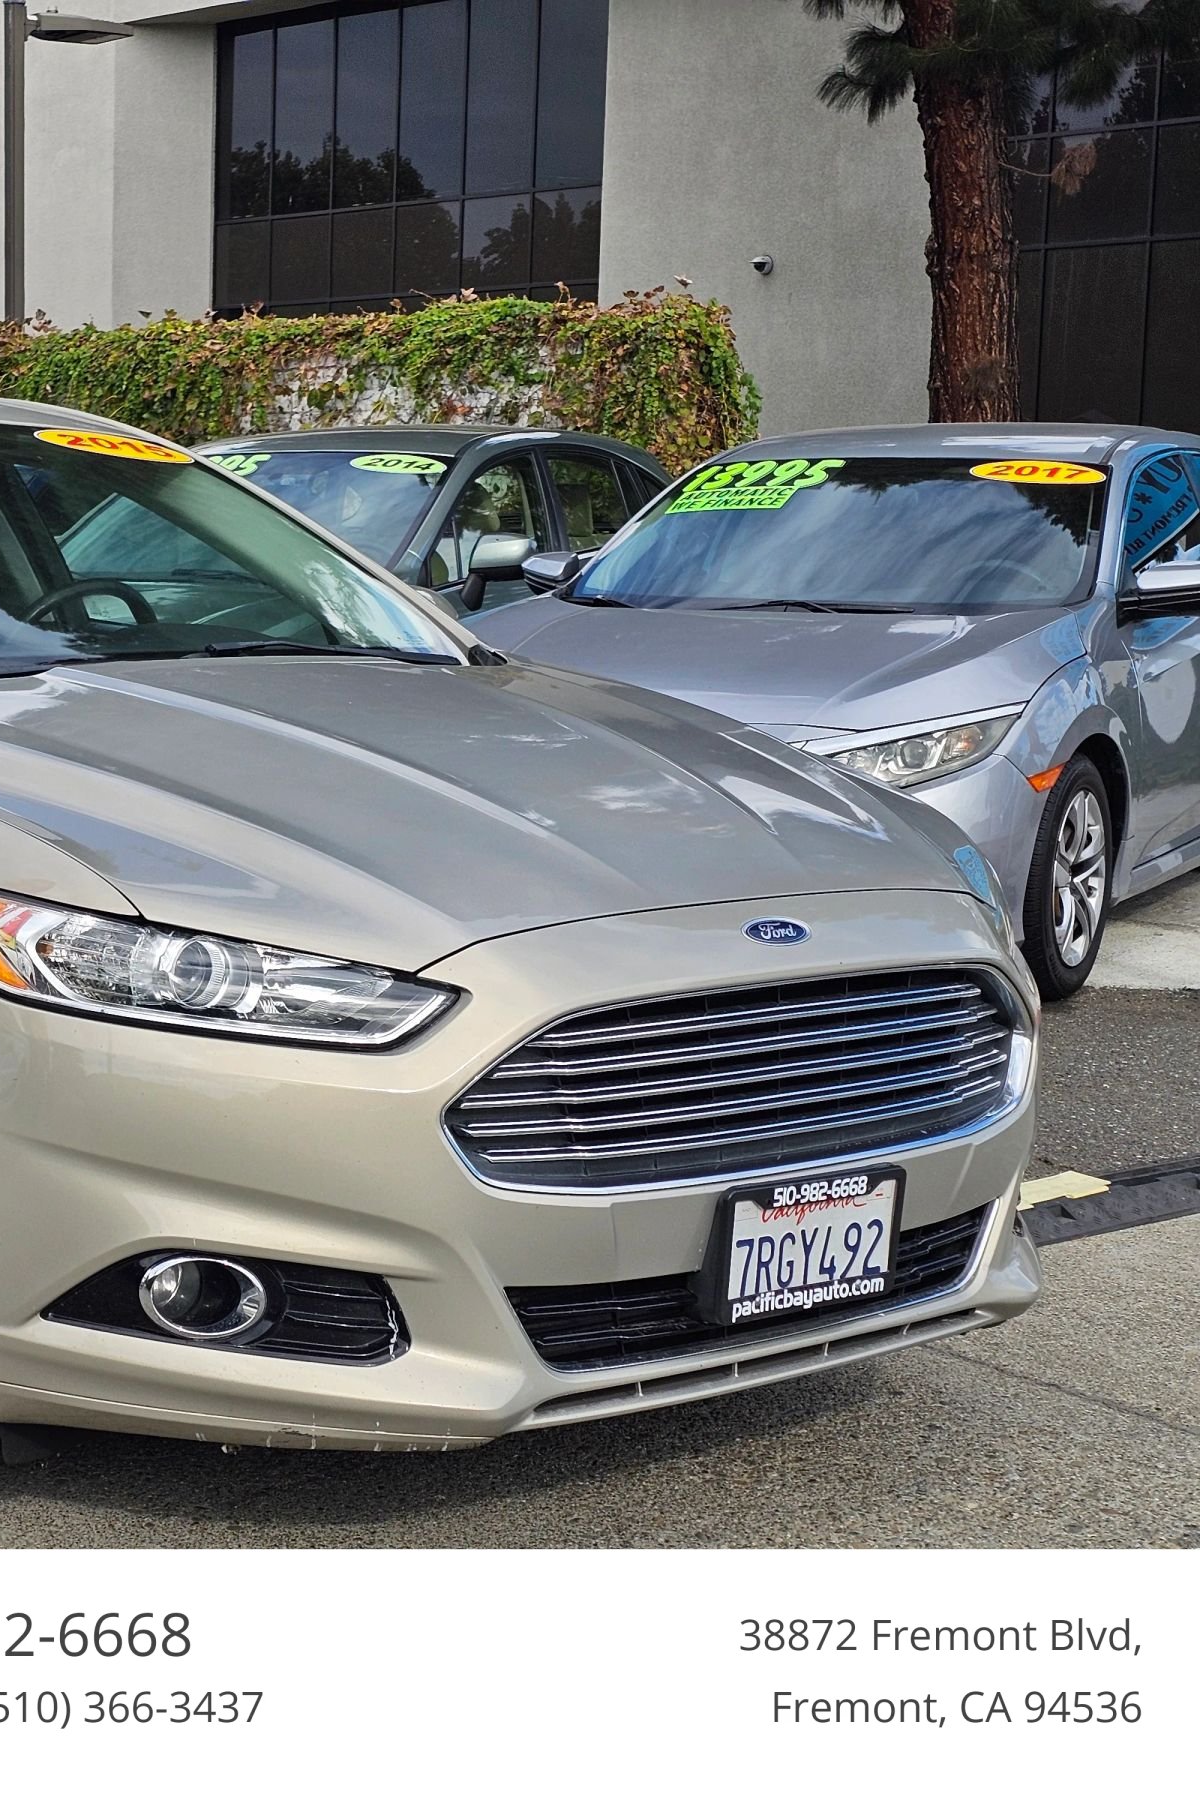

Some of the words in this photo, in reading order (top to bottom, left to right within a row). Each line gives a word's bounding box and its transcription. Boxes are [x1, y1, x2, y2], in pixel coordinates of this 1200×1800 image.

[57, 433, 173, 458] 2015
[368, 457, 435, 472] 2014
[988, 464, 1089, 479] 2017
[683, 459, 847, 492] 13995
[671, 500, 699, 511] WE
[699, 496, 782, 508] FINANCE
[679, 488, 791, 501] AUTOMATIC
[759, 921, 798, 939] Ford
[772, 1175, 869, 1207] 510-982-6668
[735, 1218, 884, 1298] 7RGY492
[731, 1277, 885, 1323] pacificbayauto.com
